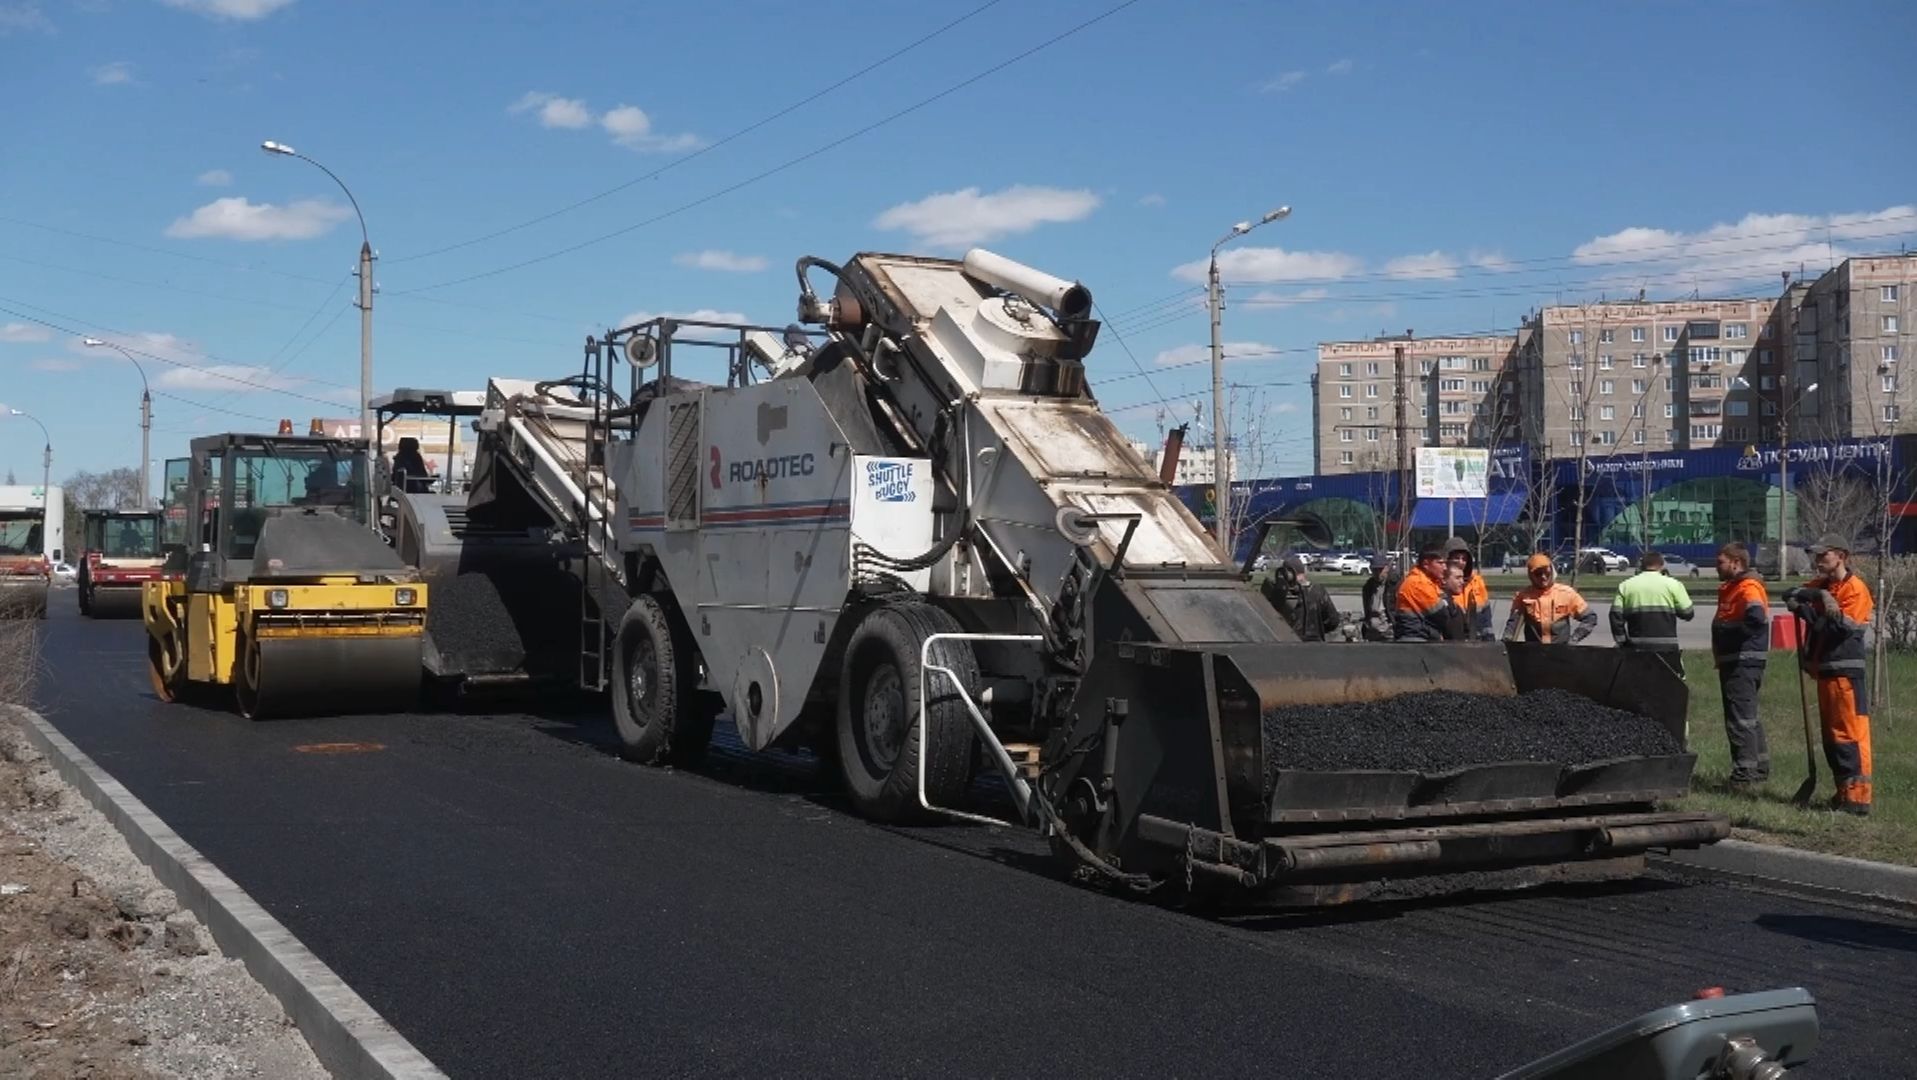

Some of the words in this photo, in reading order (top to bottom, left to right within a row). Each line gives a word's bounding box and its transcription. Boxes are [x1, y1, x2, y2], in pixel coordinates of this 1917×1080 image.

[730, 453, 815, 482] ROADTEC
[868, 463, 914, 486] SHUTTLE
[875, 480, 911, 501] BUGGY
